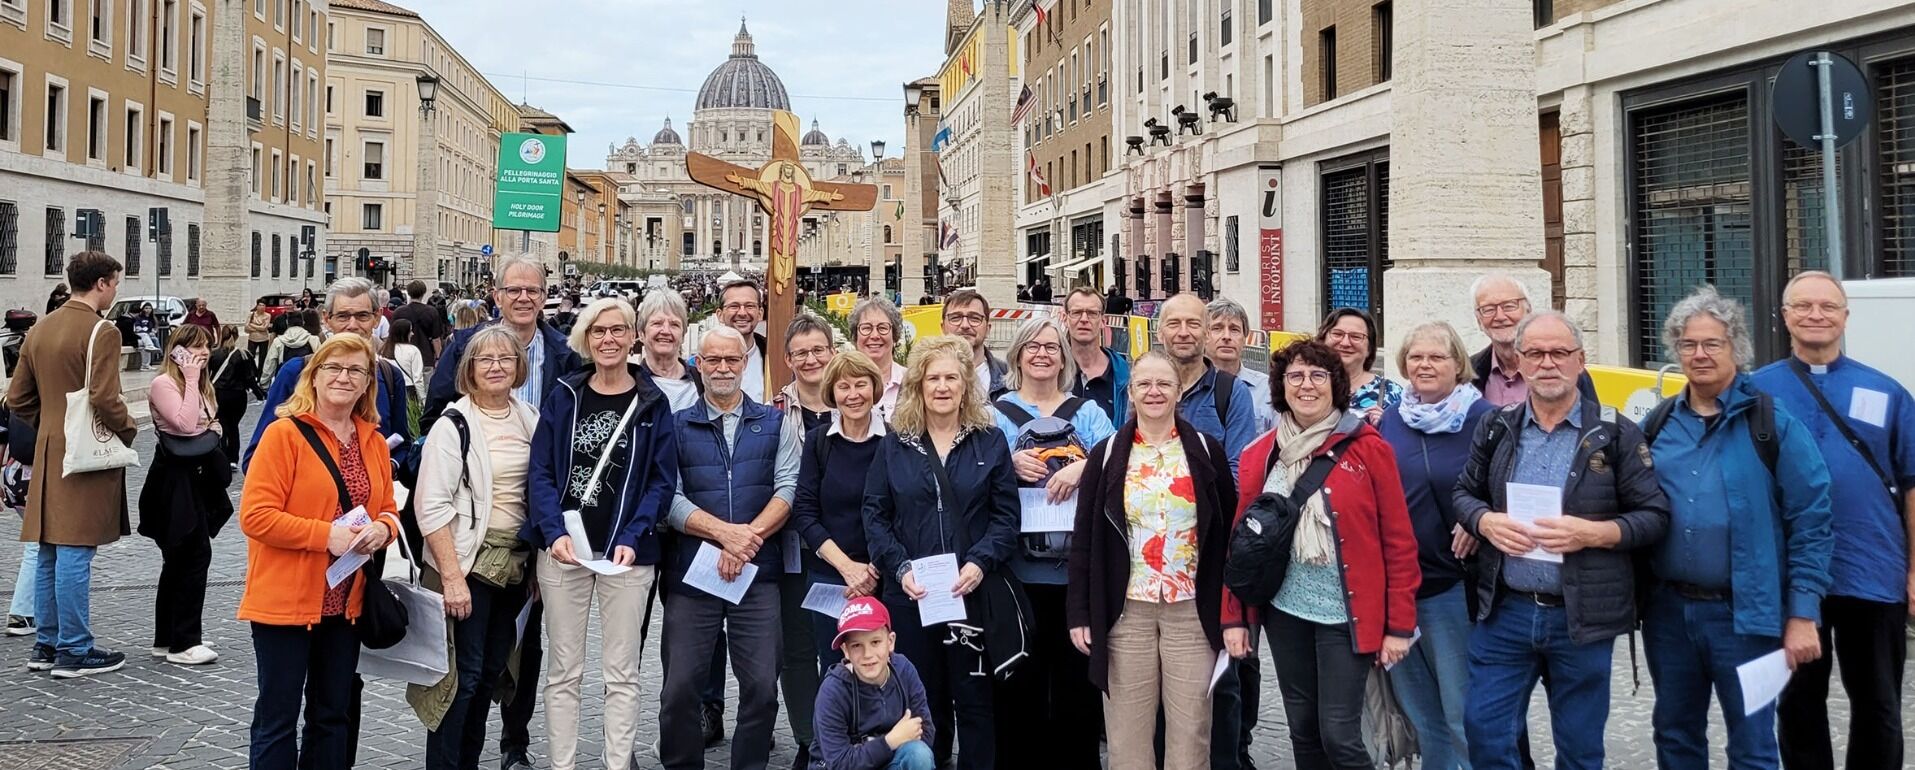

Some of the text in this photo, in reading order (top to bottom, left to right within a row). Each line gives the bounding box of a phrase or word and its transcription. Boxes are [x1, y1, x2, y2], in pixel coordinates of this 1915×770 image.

[504, 169, 557, 178] PELLEGRINAGGIO
[517, 176, 538, 184] PORTA
[539, 177, 560, 185] SANTA
[1263, 178, 1278, 218] i
[508, 211, 545, 219] PILGRIMAGE
[1261, 234, 1271, 305] TOURIST
[1270, 234, 1281, 305] INFOPOINT
